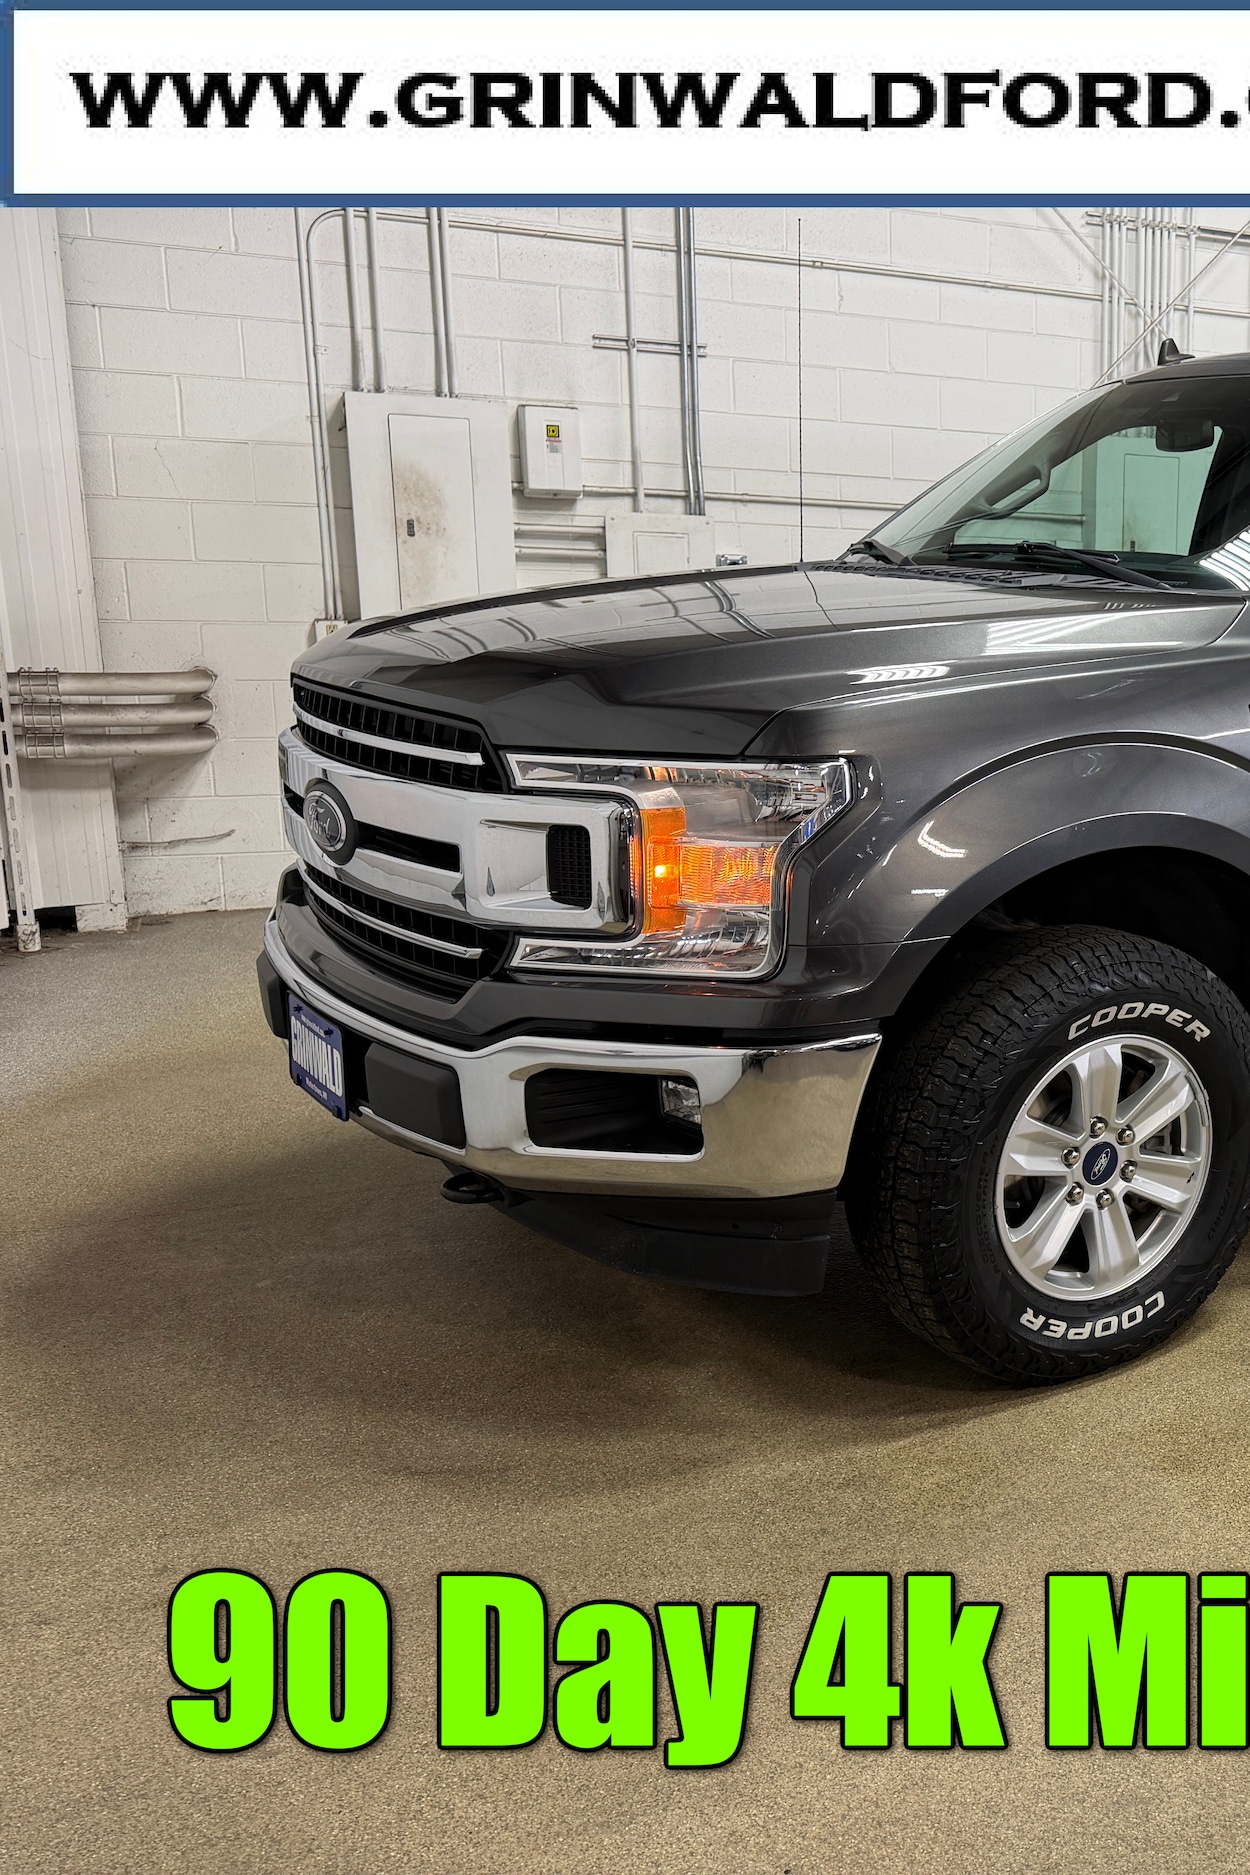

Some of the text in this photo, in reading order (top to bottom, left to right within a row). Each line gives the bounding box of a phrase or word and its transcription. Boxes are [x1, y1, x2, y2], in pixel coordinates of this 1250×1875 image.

[308, 802, 332, 837] Ford
[1067, 1001, 1212, 1042] COOPER
[291, 1015, 343, 1097] GRINWALD
[1019, 1290, 1166, 1341] COOPER
